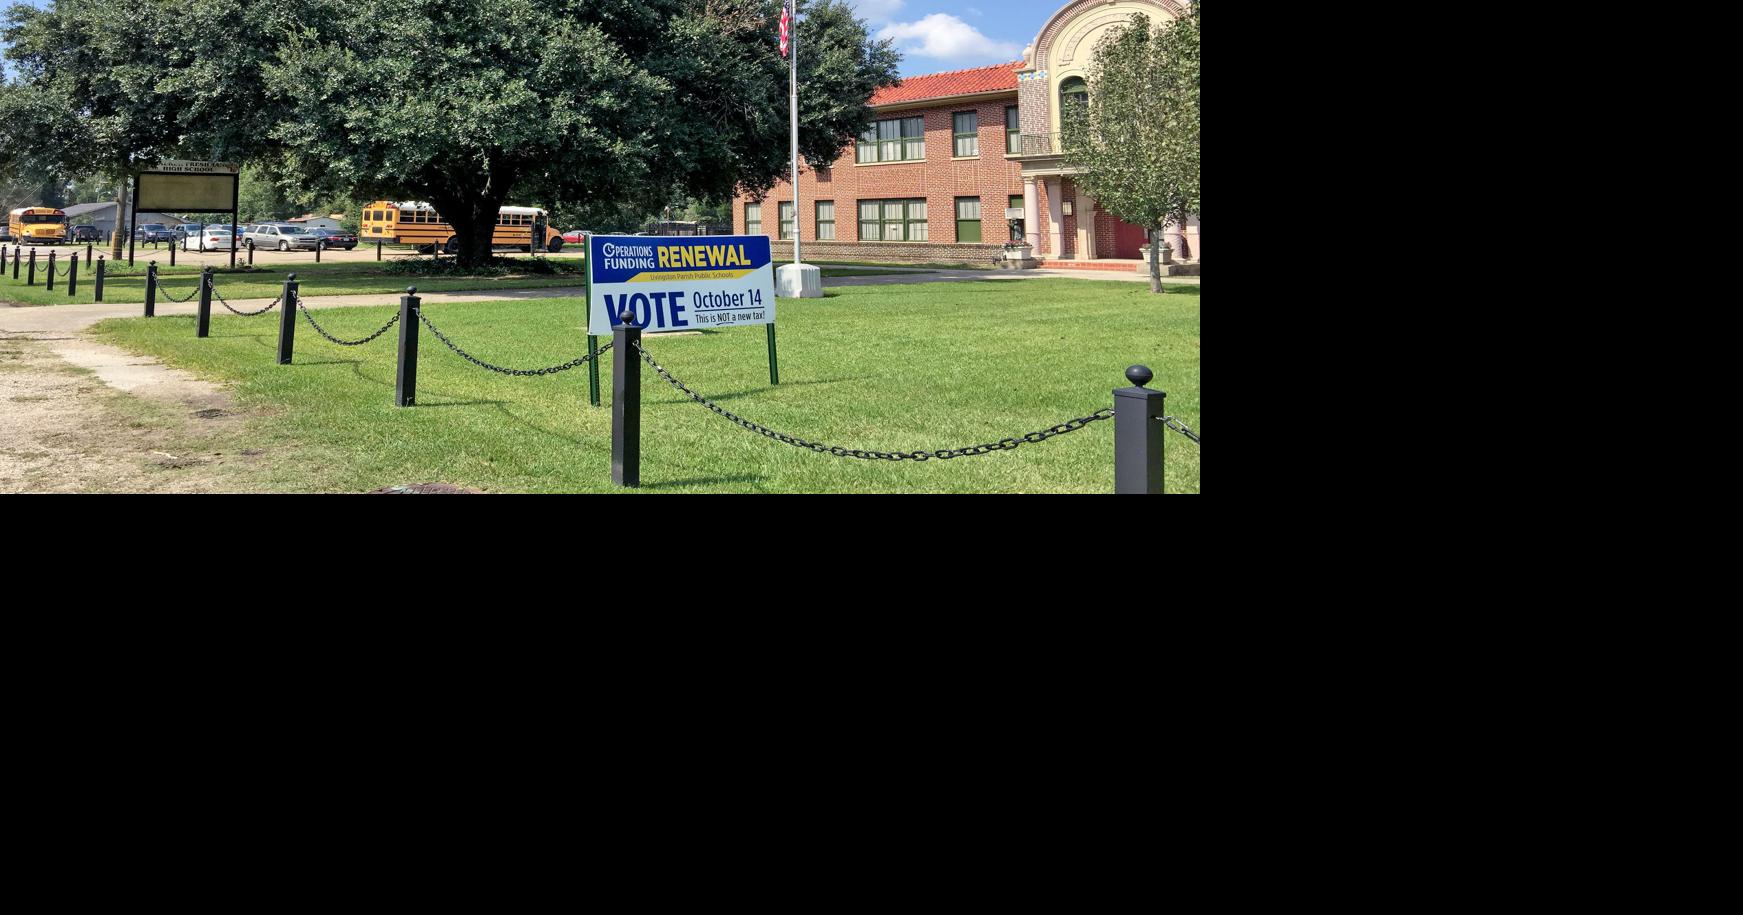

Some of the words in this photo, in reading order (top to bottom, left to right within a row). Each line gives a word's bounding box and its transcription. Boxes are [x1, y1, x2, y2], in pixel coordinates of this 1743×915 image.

[604, 257, 655, 270] FUNDING
[657, 244, 752, 268] RENEWAL
[712, 271, 734, 279] Schools
[693, 289, 745, 309] October
[748, 288, 762, 306] 14
[603, 291, 689, 331] VOTE
[695, 313, 709, 323] This
[709, 313, 717, 323] is
[717, 312, 732, 322] NOT
[737, 313, 752, 321] new
[752, 310, 766, 320] tax!
